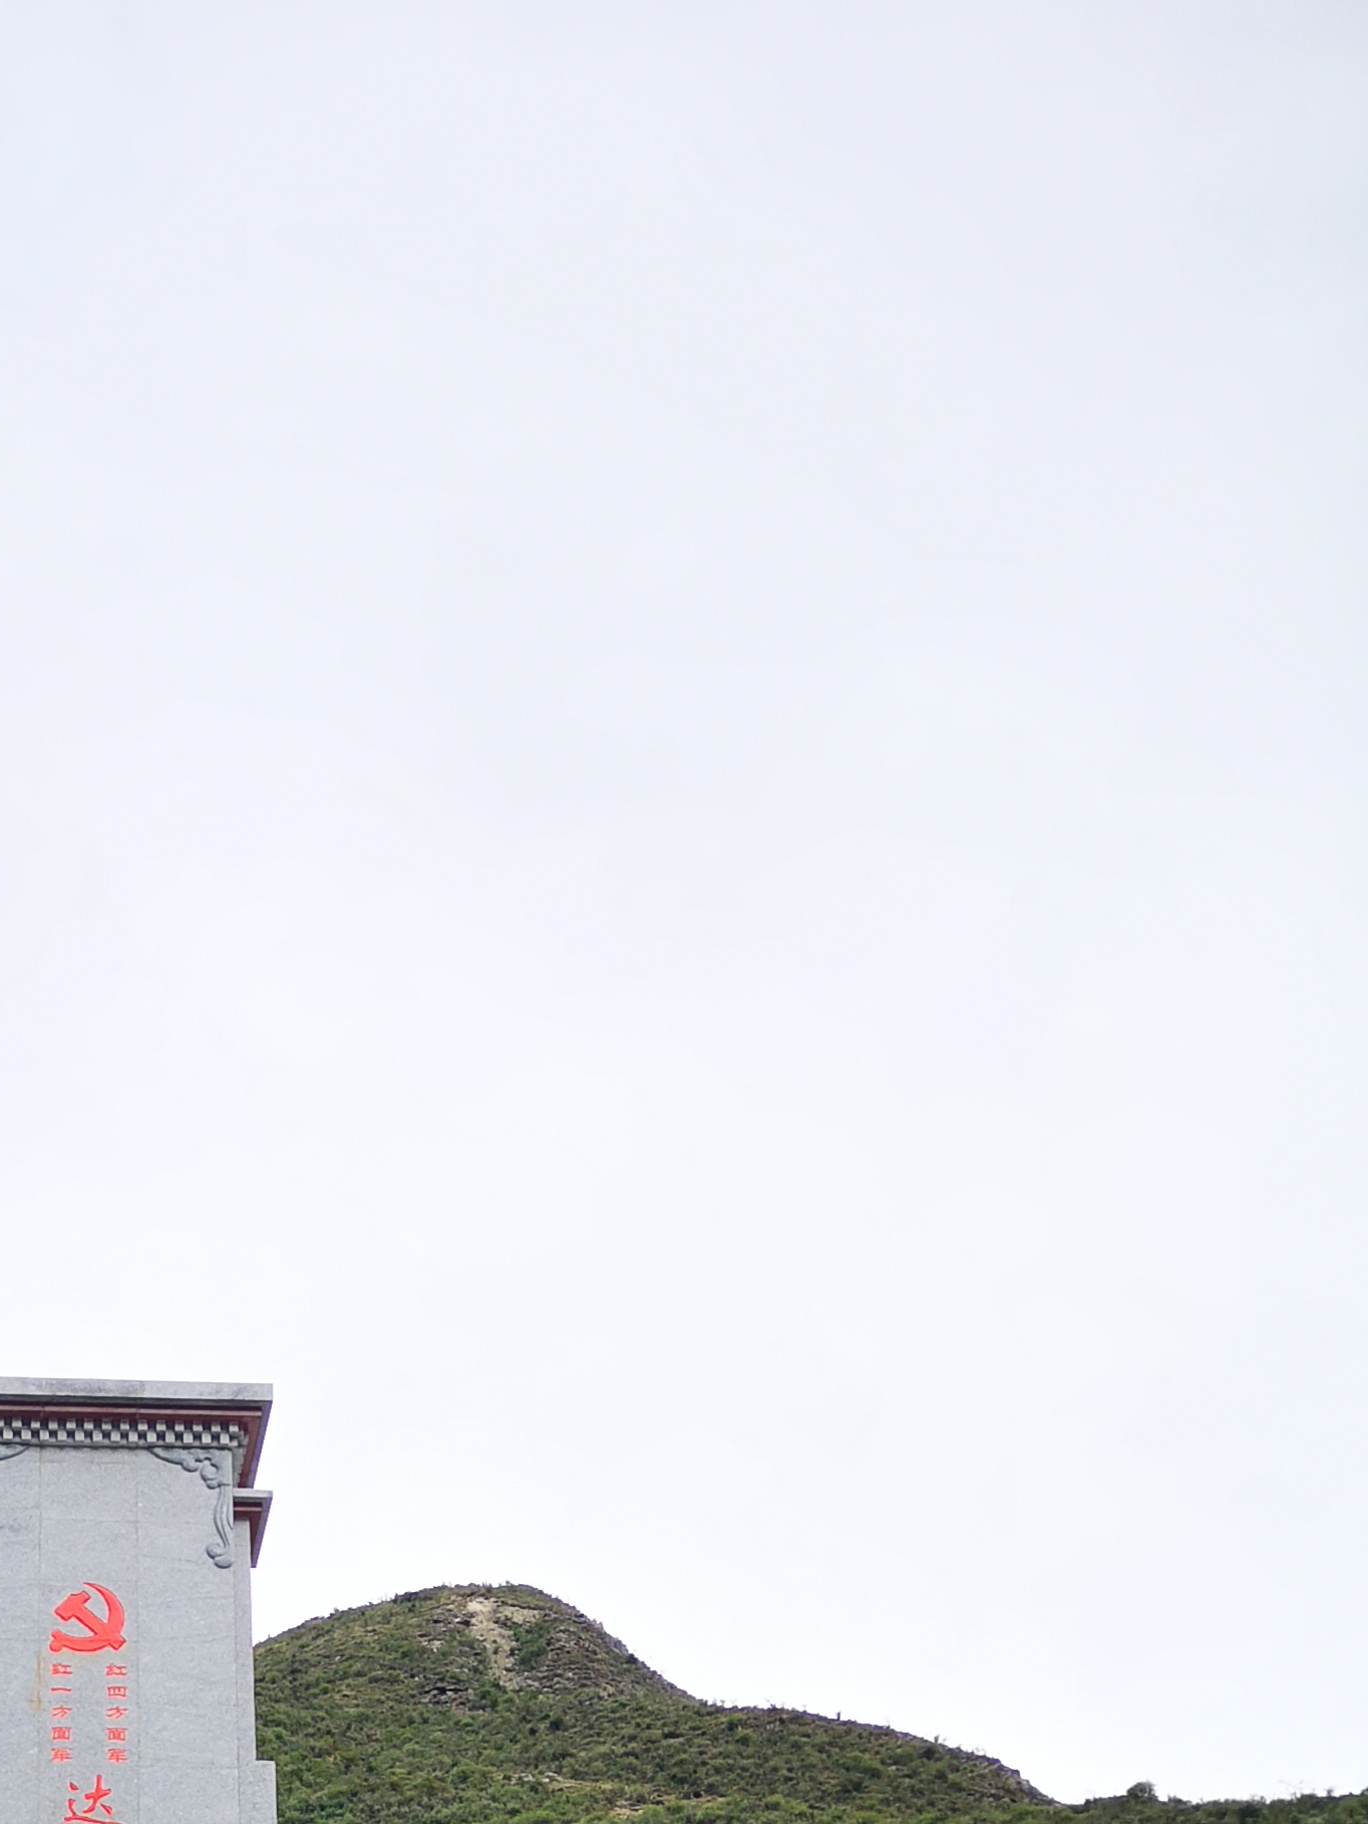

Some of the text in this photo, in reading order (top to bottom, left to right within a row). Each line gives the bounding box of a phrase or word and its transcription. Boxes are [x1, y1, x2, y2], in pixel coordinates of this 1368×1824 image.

[50, 1662, 73, 1762] 红一方面军
[105, 1663, 128, 1763] 红四方面军
